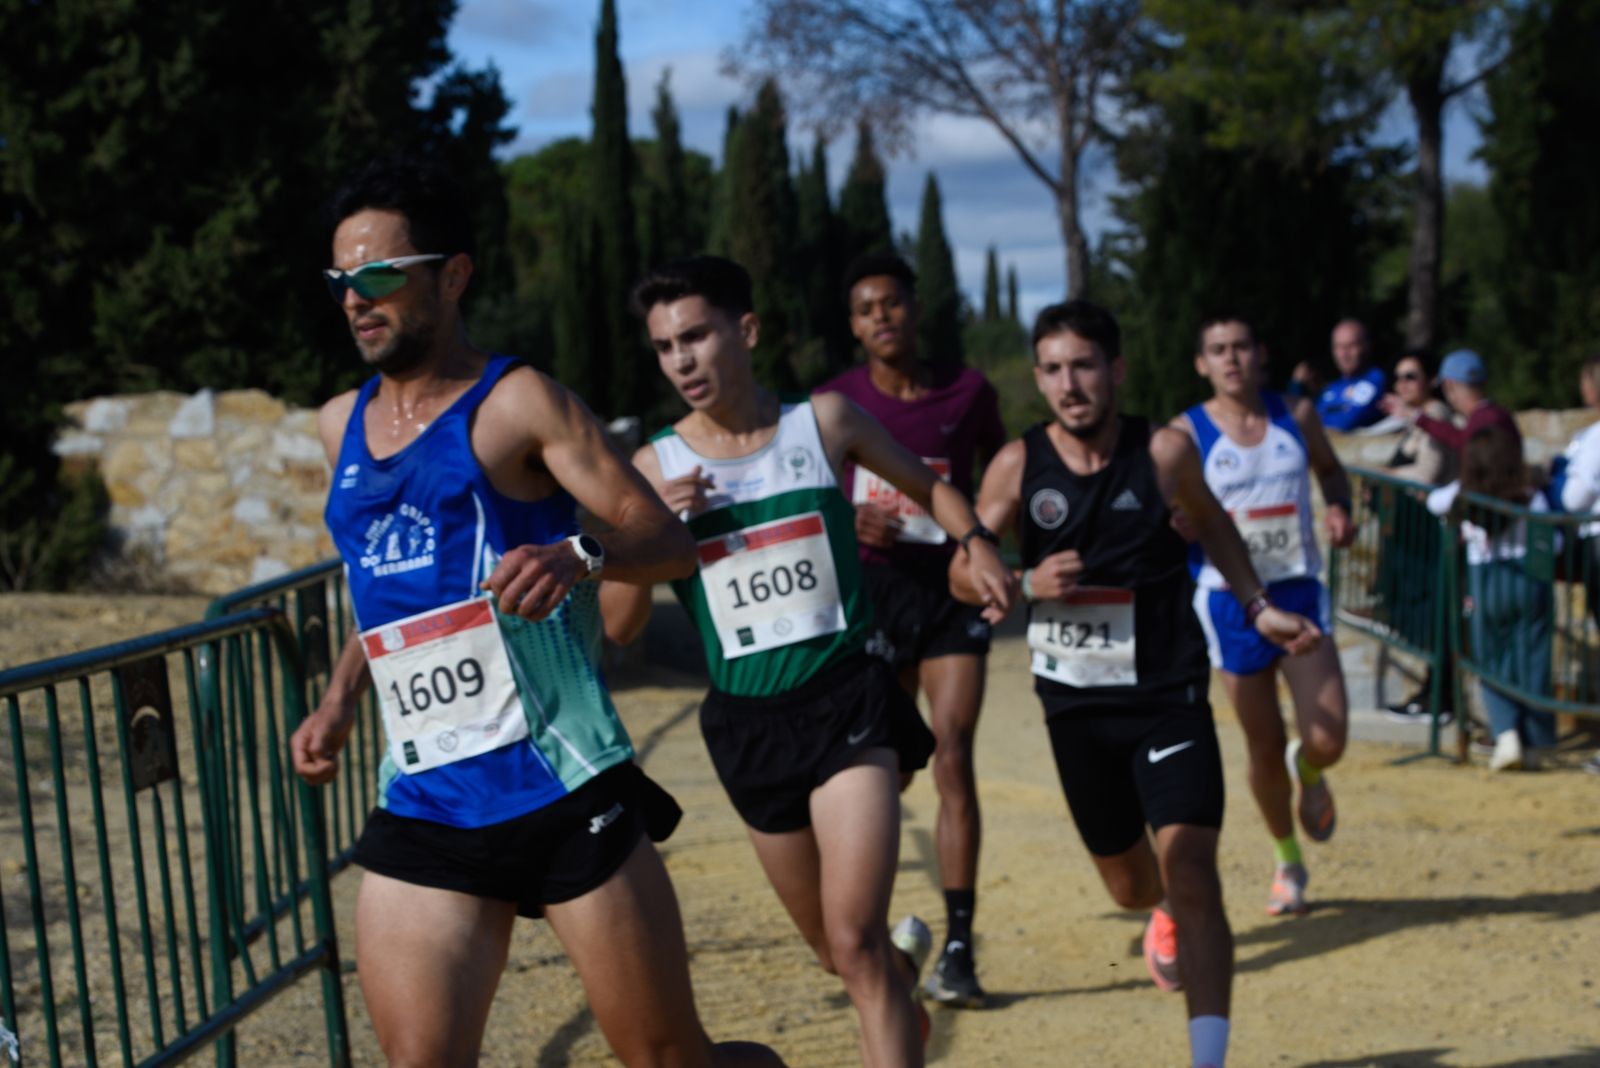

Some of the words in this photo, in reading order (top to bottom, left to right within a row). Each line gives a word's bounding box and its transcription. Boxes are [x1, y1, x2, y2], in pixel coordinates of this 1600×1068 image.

[726, 559, 818, 610] 1608
[1045, 616, 1114, 649] 1621
[390, 657, 485, 717] 1609
